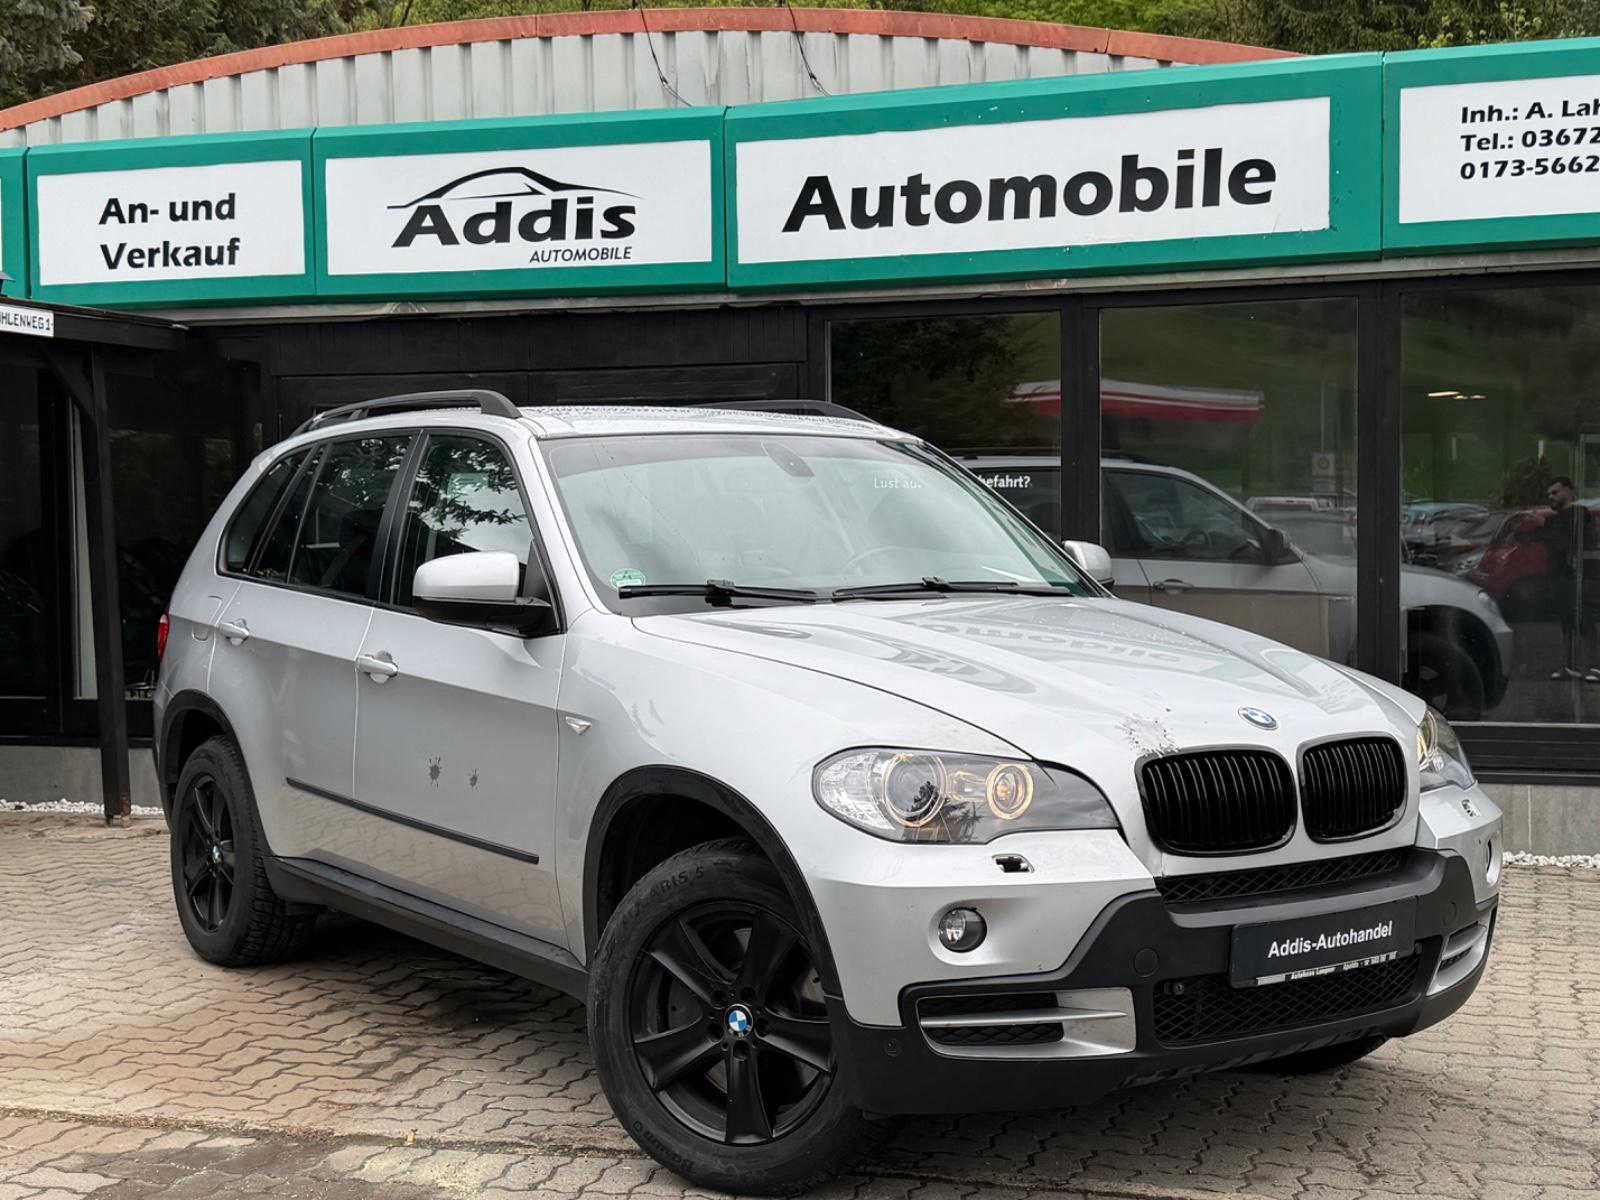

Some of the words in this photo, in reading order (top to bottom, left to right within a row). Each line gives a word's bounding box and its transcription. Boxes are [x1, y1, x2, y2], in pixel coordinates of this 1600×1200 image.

[1461, 104, 1519, 124] Inh.:
[1525, 101, 1553, 120] A.
[1460, 132, 1514, 152] Tel.:
[1521, 126, 1600, 148] 03672
[1459, 155, 1600, 180] 0173-5662
[781, 147, 1277, 233] Automobile
[98, 196, 159, 225] An-
[169, 192, 236, 222] und
[391, 196, 637, 248] Addis
[100, 237, 241, 270] Verkauf
[529, 245, 632, 264] AUTOMOBILE
[0, 312, 50, 331] HLENWEG1
[873, 477, 898, 489] Lust
[1267, 920, 1393, 959] Addis-Autohandel
